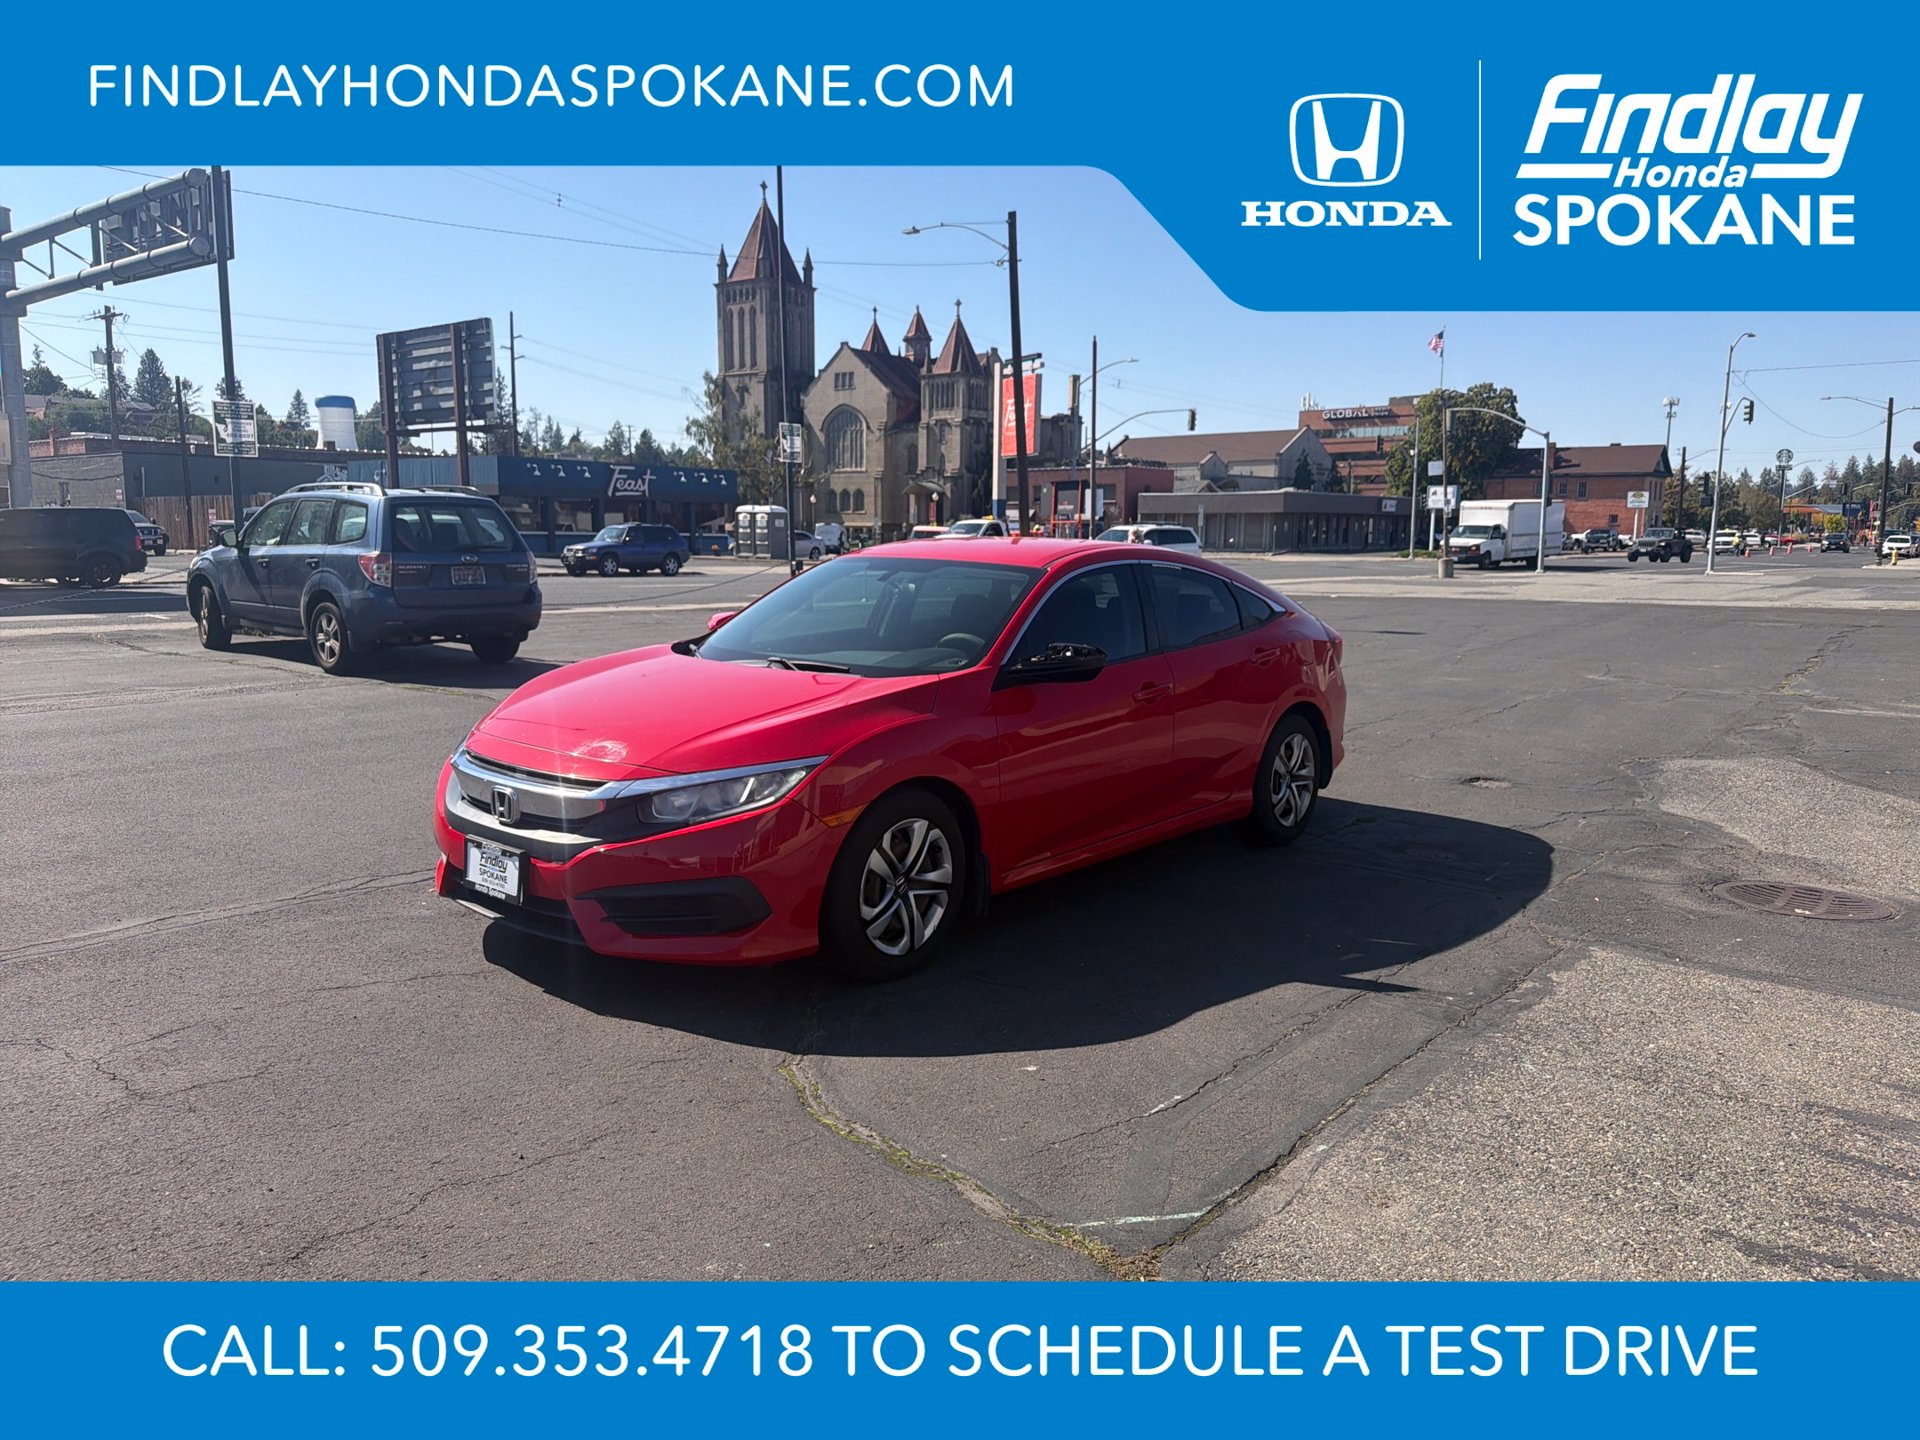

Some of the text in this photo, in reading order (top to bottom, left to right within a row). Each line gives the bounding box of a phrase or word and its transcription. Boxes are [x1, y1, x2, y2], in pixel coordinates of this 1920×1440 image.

[1322, 408, 1369, 419] GLOBAL
[608, 464, 657, 497] Feast
[479, 851, 508, 873] Findlay
[479, 867, 508, 884] SPOKANE
